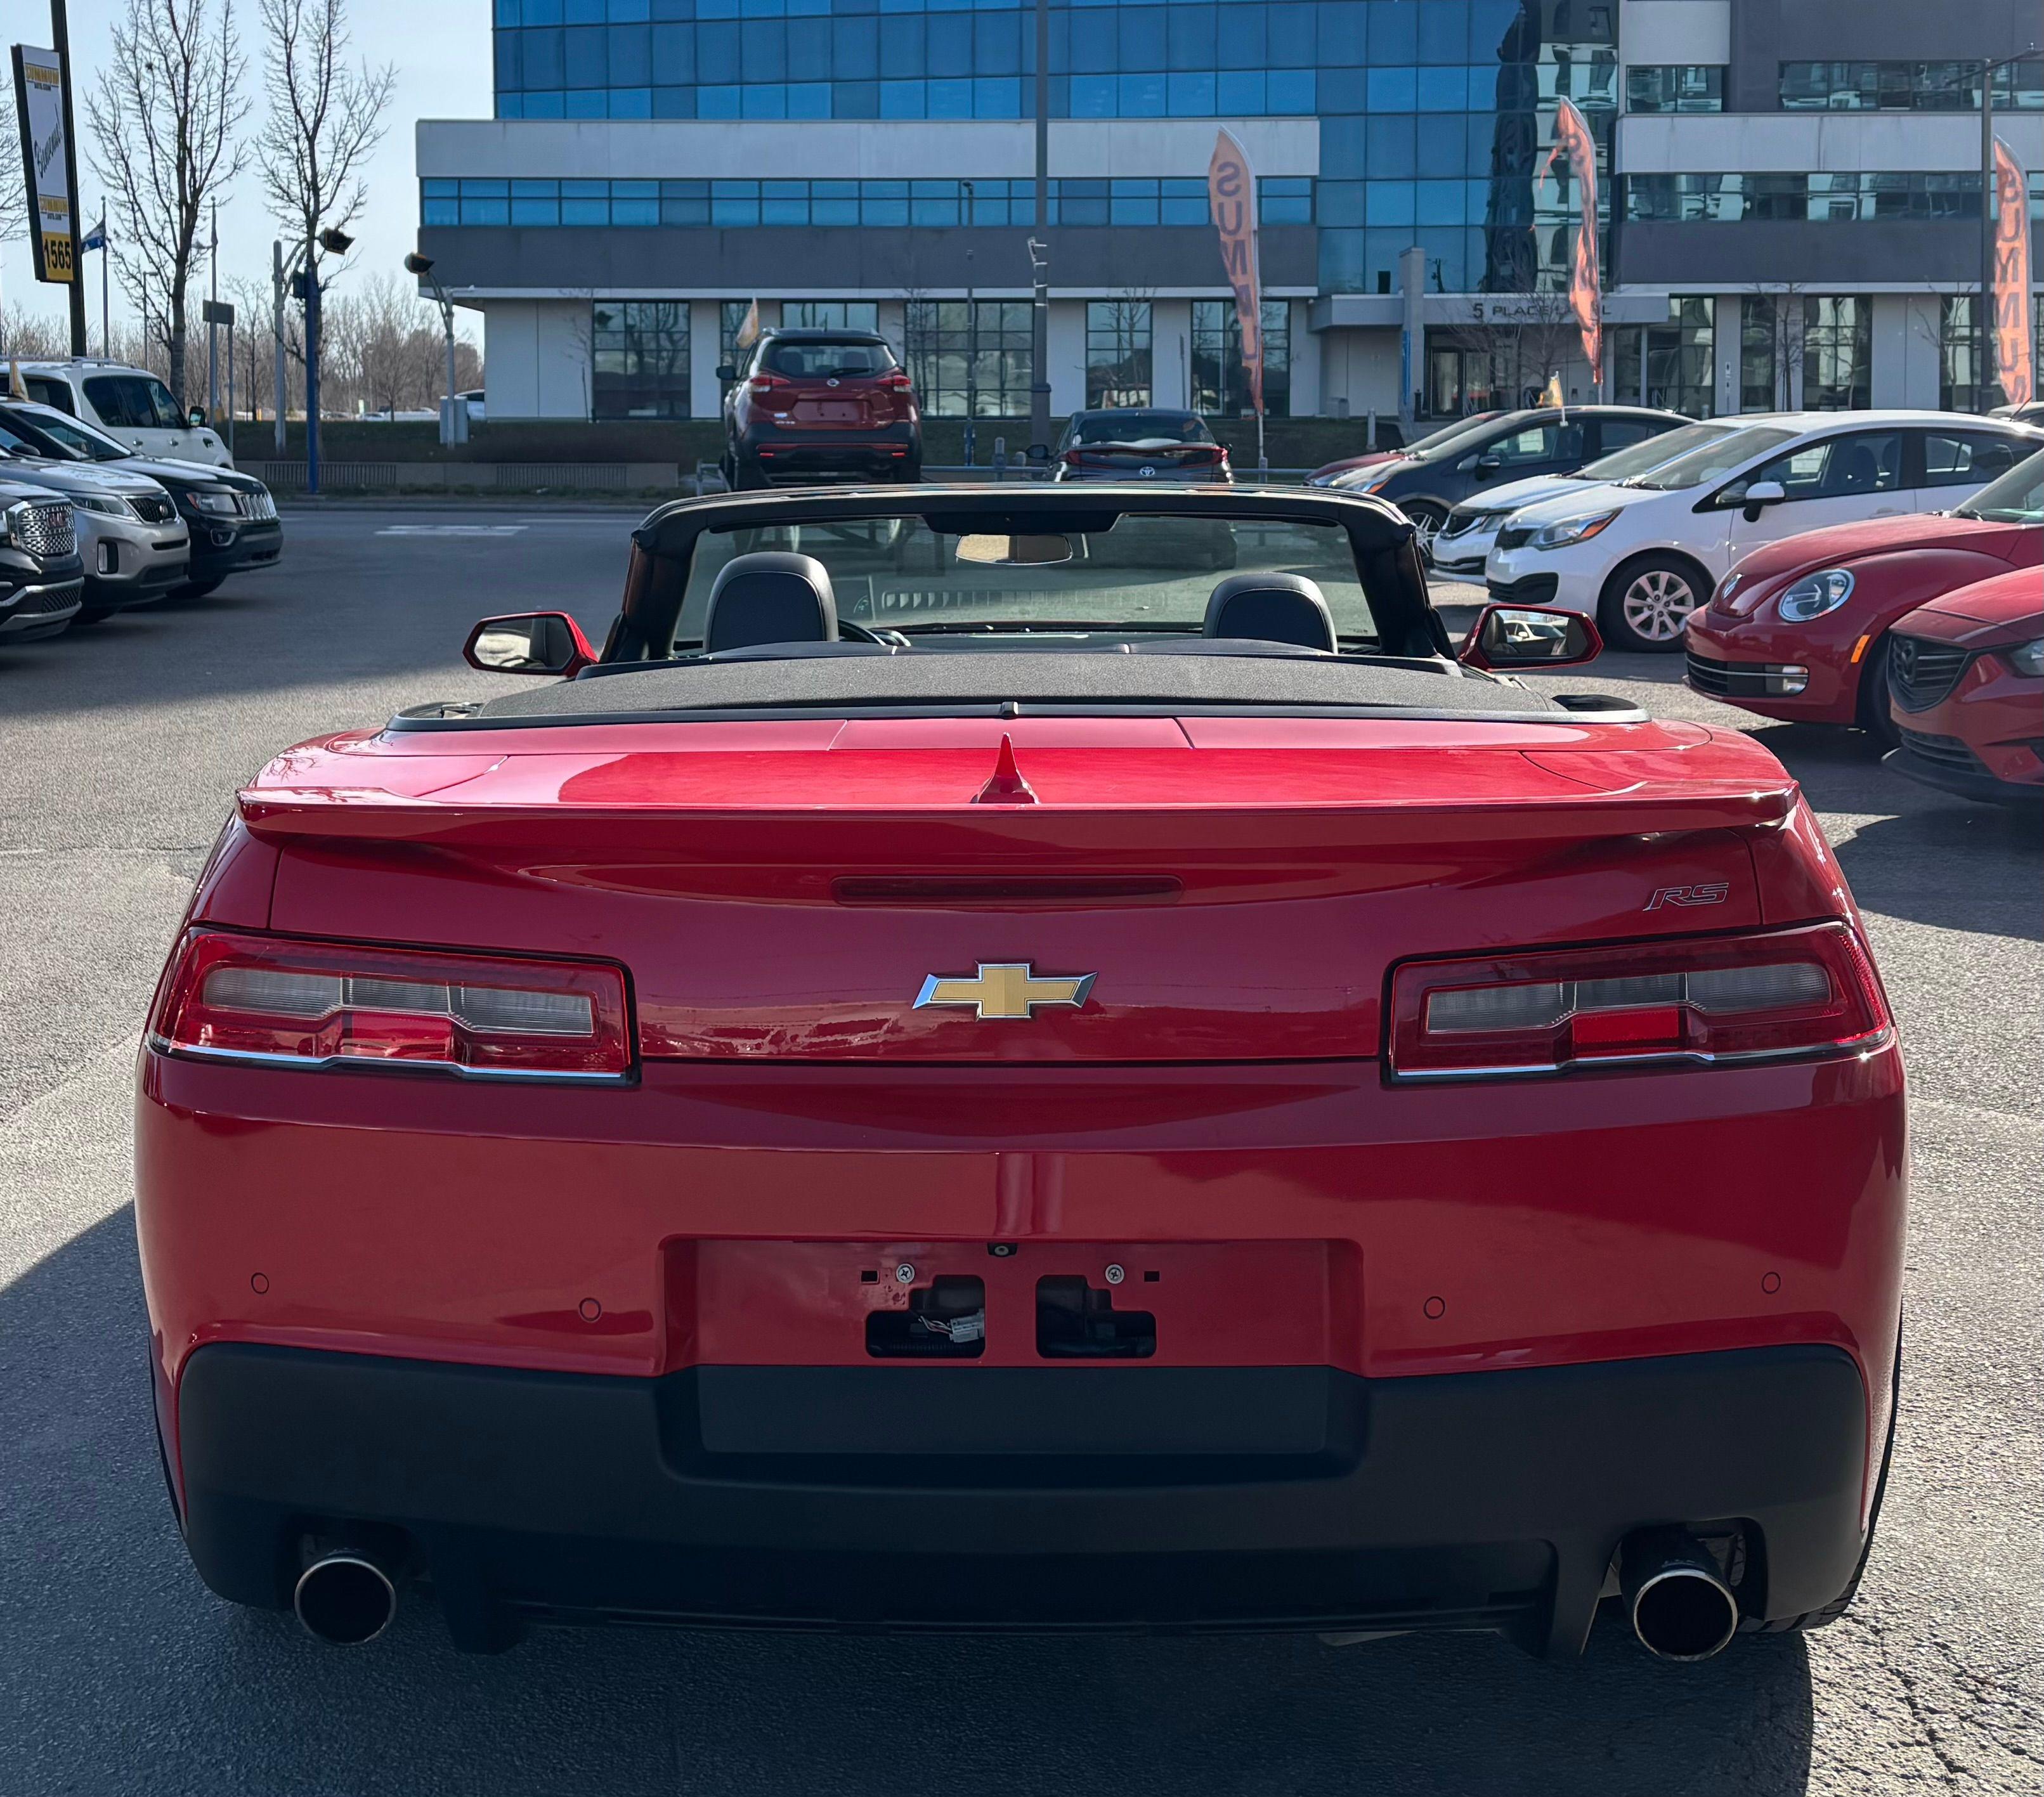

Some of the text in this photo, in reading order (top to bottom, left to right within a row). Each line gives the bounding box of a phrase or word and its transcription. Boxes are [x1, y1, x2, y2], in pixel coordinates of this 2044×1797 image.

[44, 239, 71, 269] 1565
[1473, 303, 1483, 318] 5
[1492, 306, 1549, 316] PLACE
[1643, 882, 1729, 911] RS
